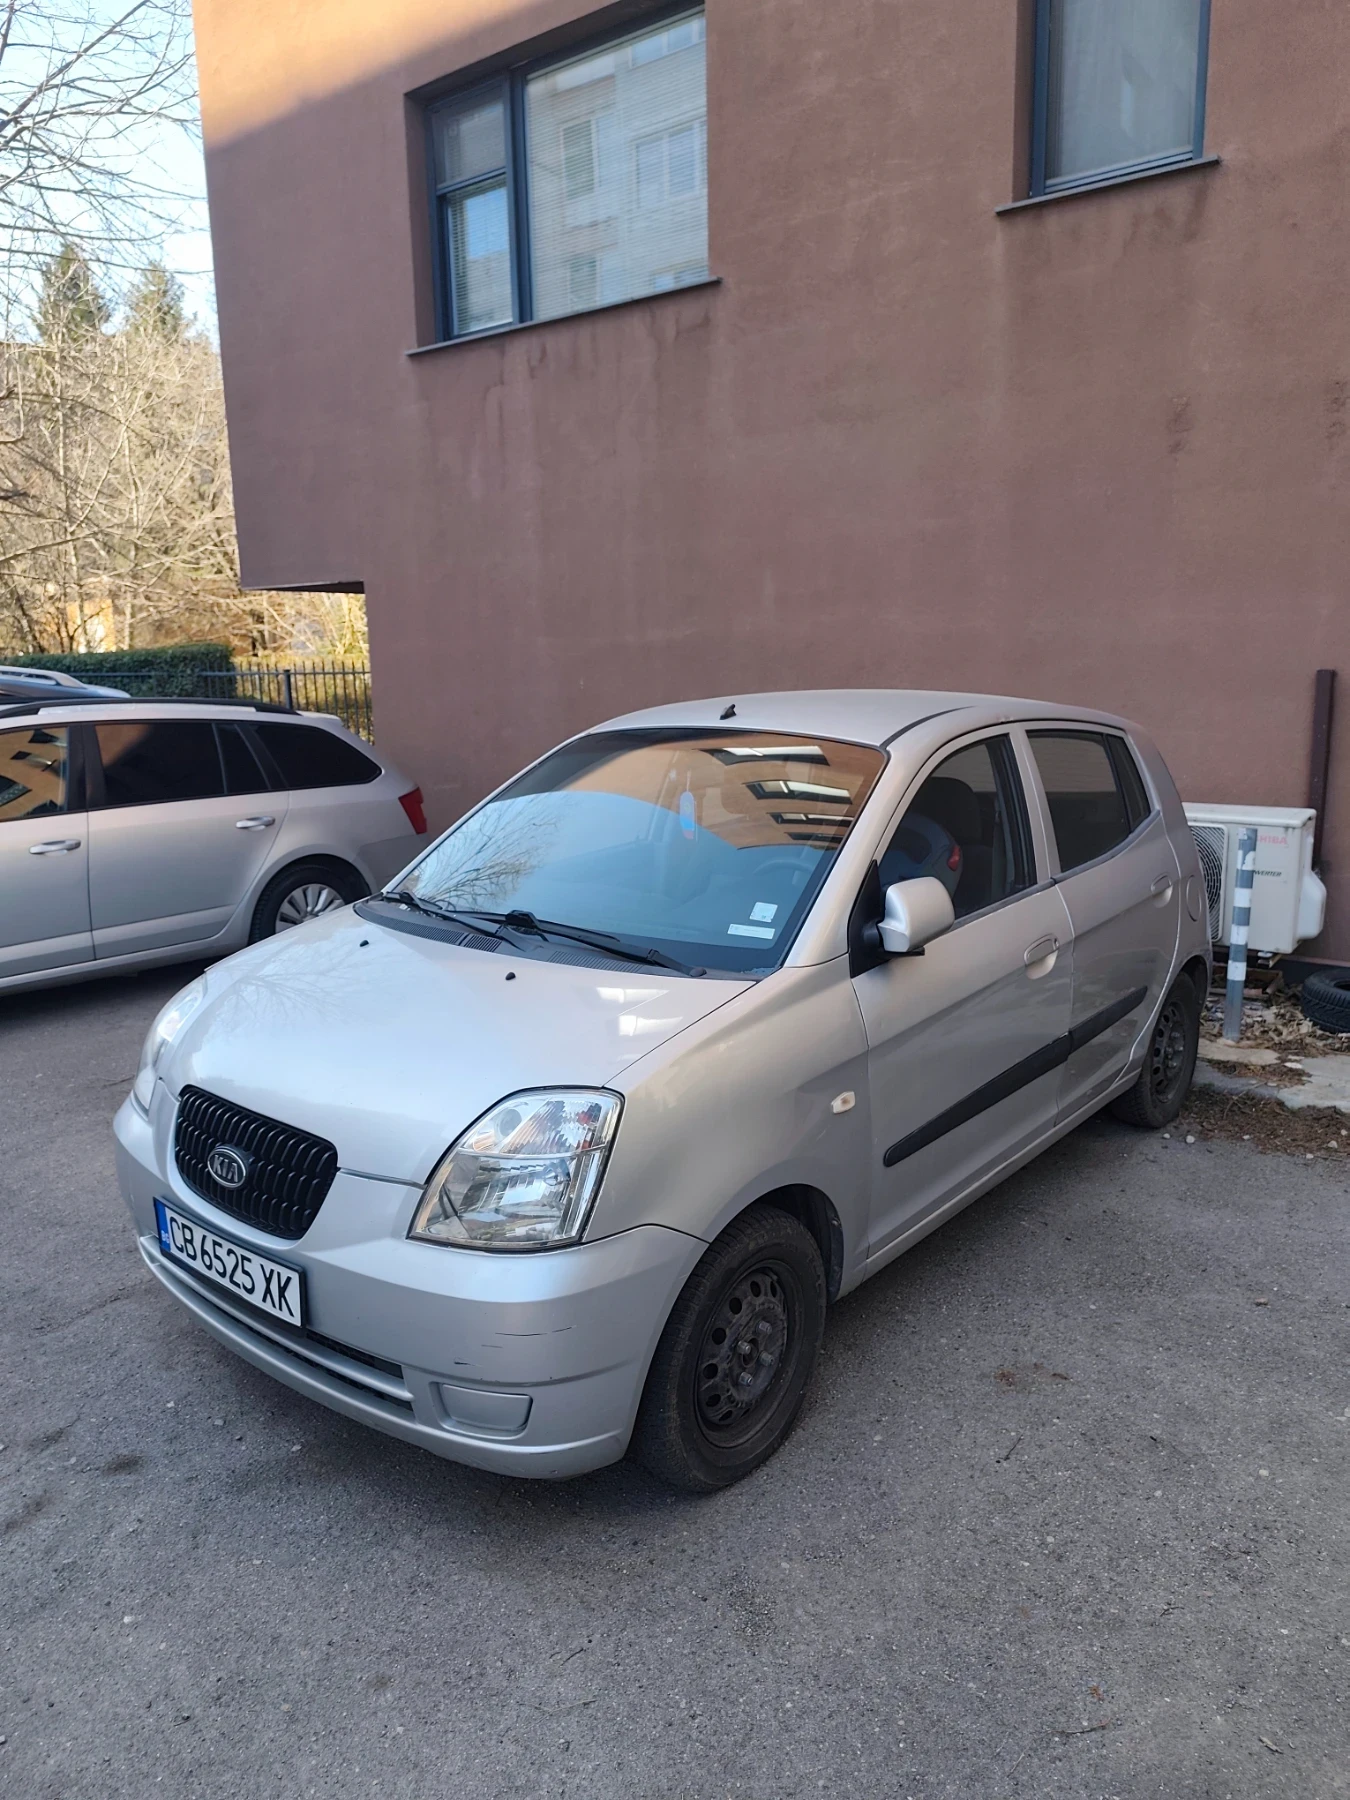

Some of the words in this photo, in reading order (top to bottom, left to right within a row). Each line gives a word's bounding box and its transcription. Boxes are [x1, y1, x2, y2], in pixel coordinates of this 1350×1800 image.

[1257, 835, 1288, 845] HIBA
[213, 1154, 239, 1183] KIA
[169, 1216, 197, 1261] CB
[200, 1234, 256, 1295] 6525
[259, 1263, 295, 1318] XK
